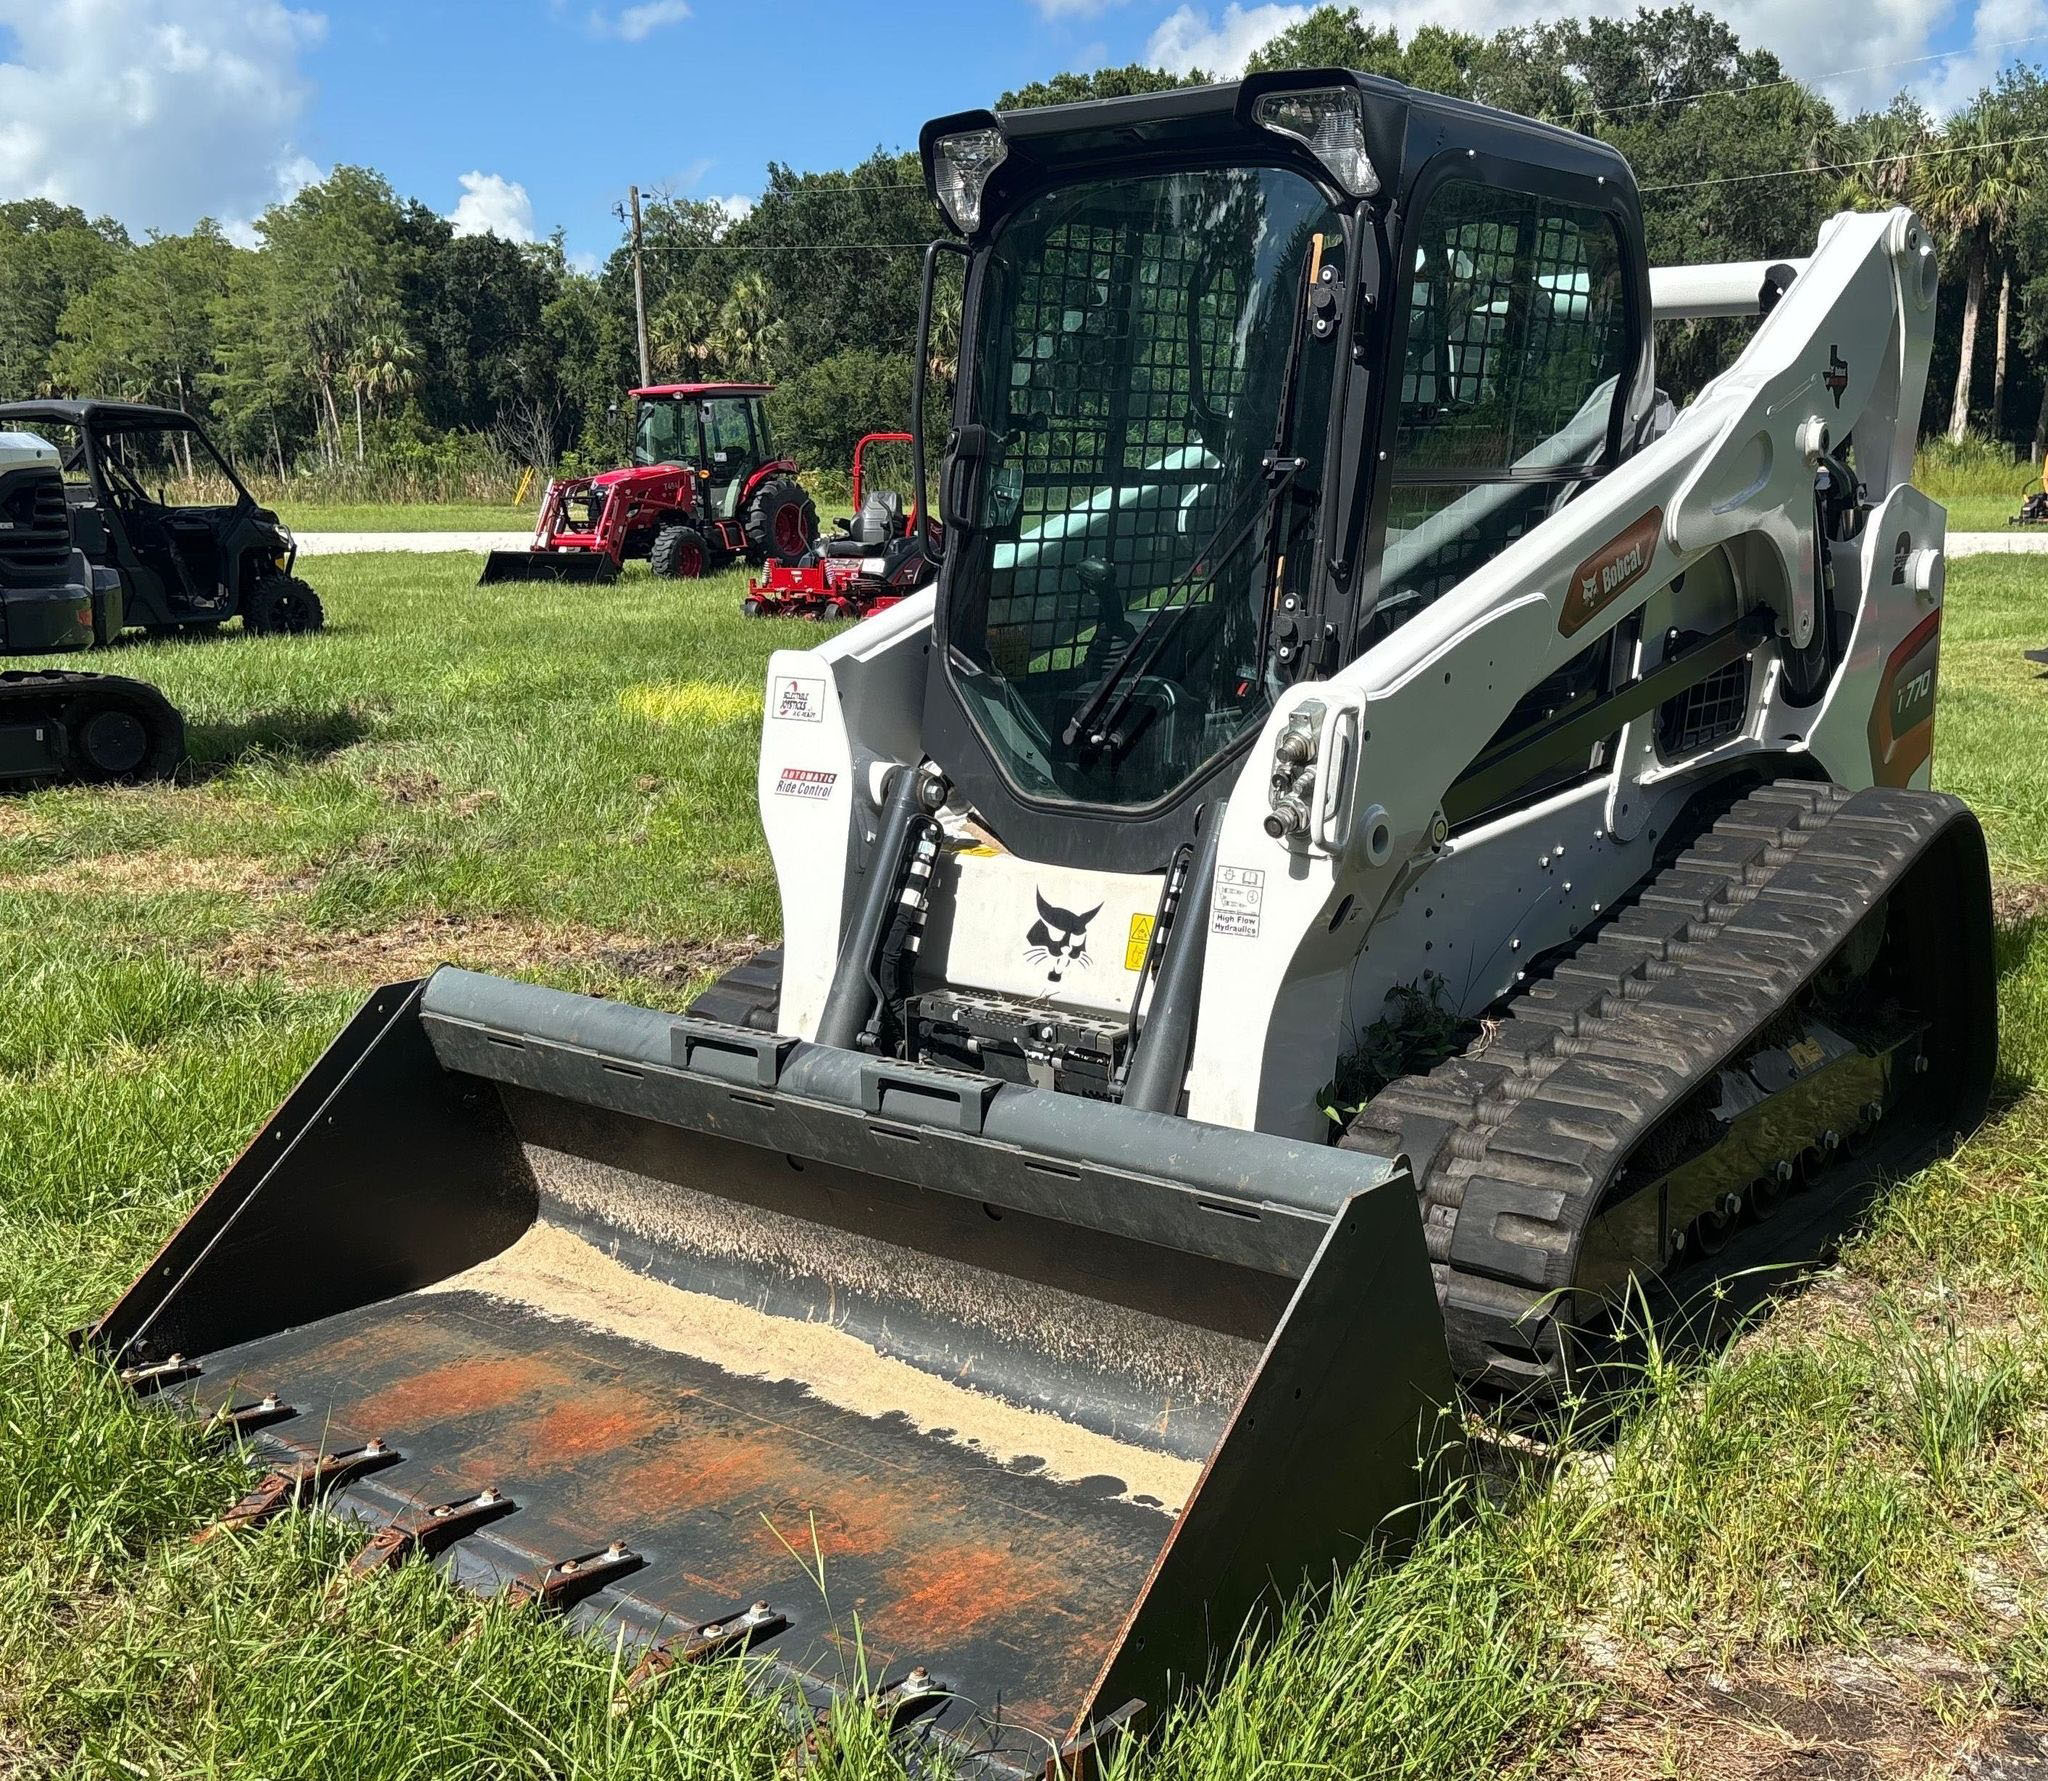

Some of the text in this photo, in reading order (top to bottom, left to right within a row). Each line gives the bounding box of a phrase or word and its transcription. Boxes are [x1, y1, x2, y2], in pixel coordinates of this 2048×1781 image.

[1602, 542, 1642, 593] Bobcat
[1897, 668, 1931, 714] T770
[782, 769, 836, 784] AUTOMATIC
[776, 780, 833, 798] Ride Control
[1217, 914, 1256, 924] High Flow
[1215, 922, 1256, 934] Hydraulics
